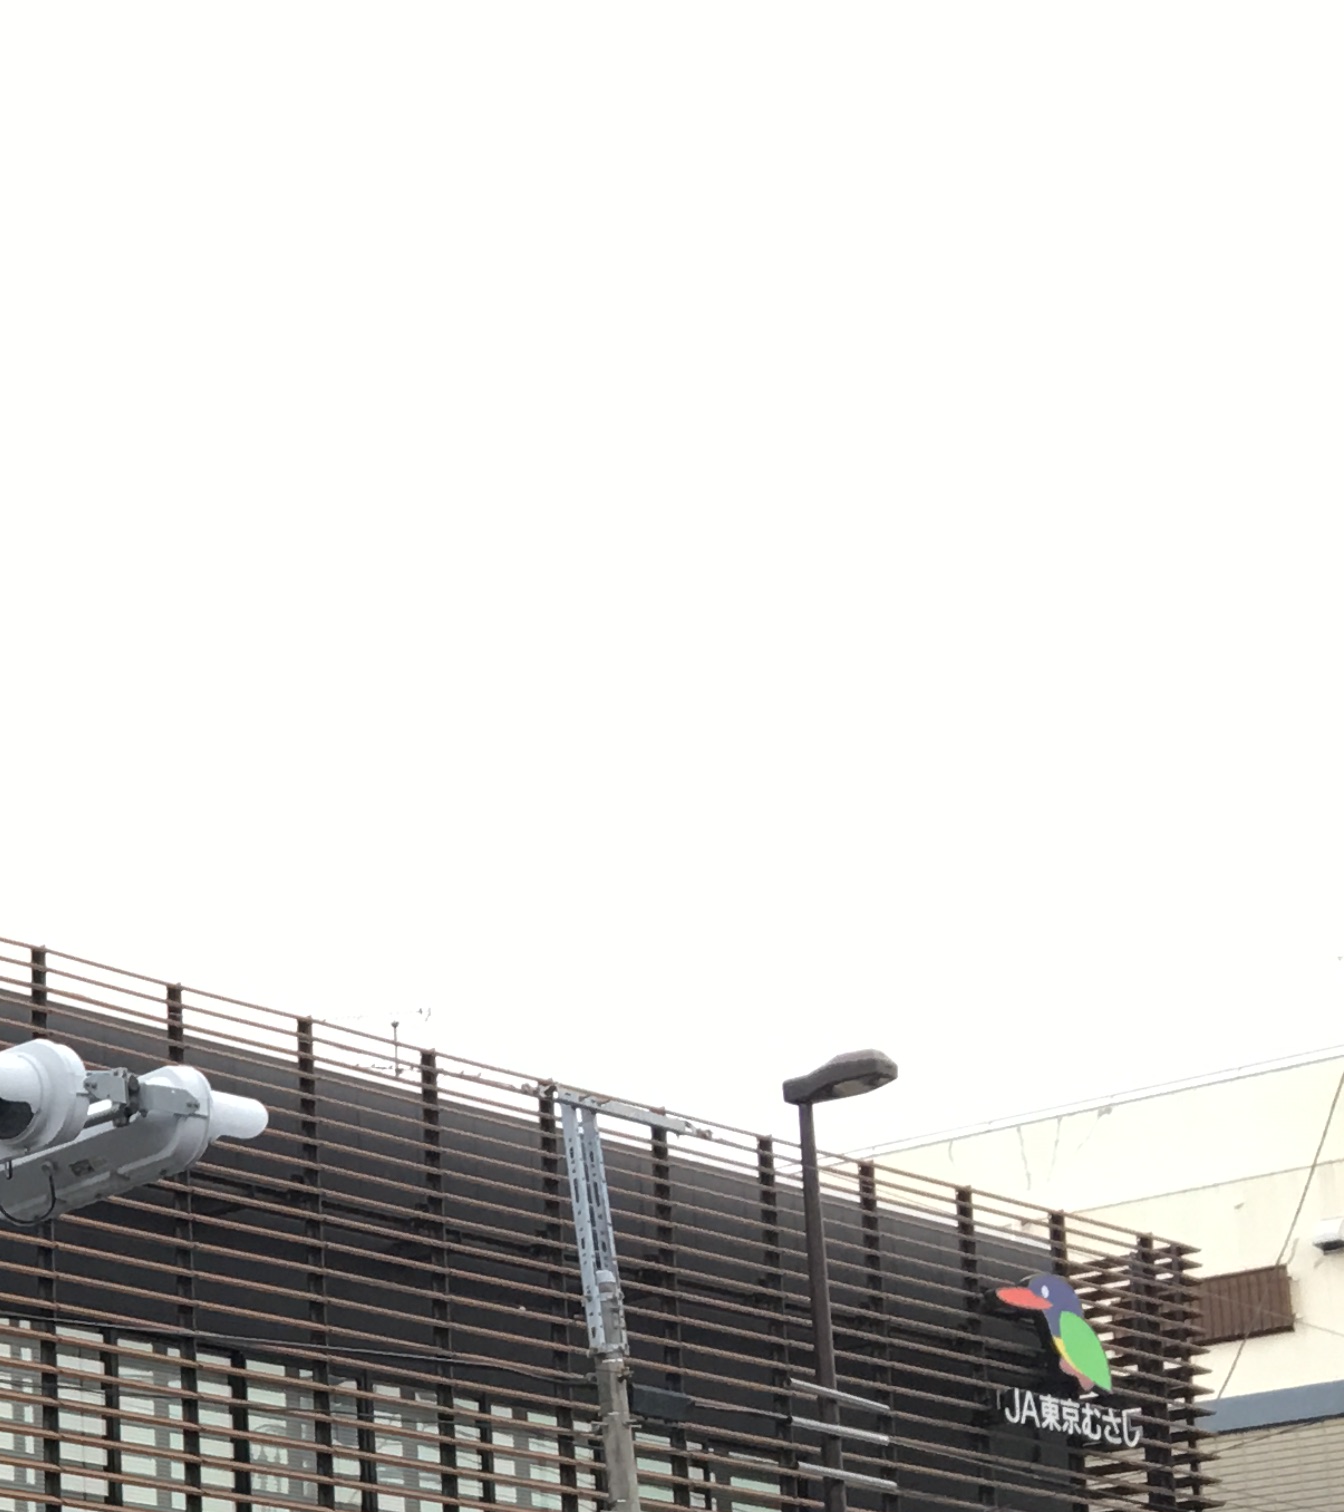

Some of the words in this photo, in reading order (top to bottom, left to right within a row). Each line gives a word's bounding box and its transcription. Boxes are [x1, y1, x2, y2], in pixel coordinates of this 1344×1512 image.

[1005, 1388, 1142, 1447] JA東京むさし
